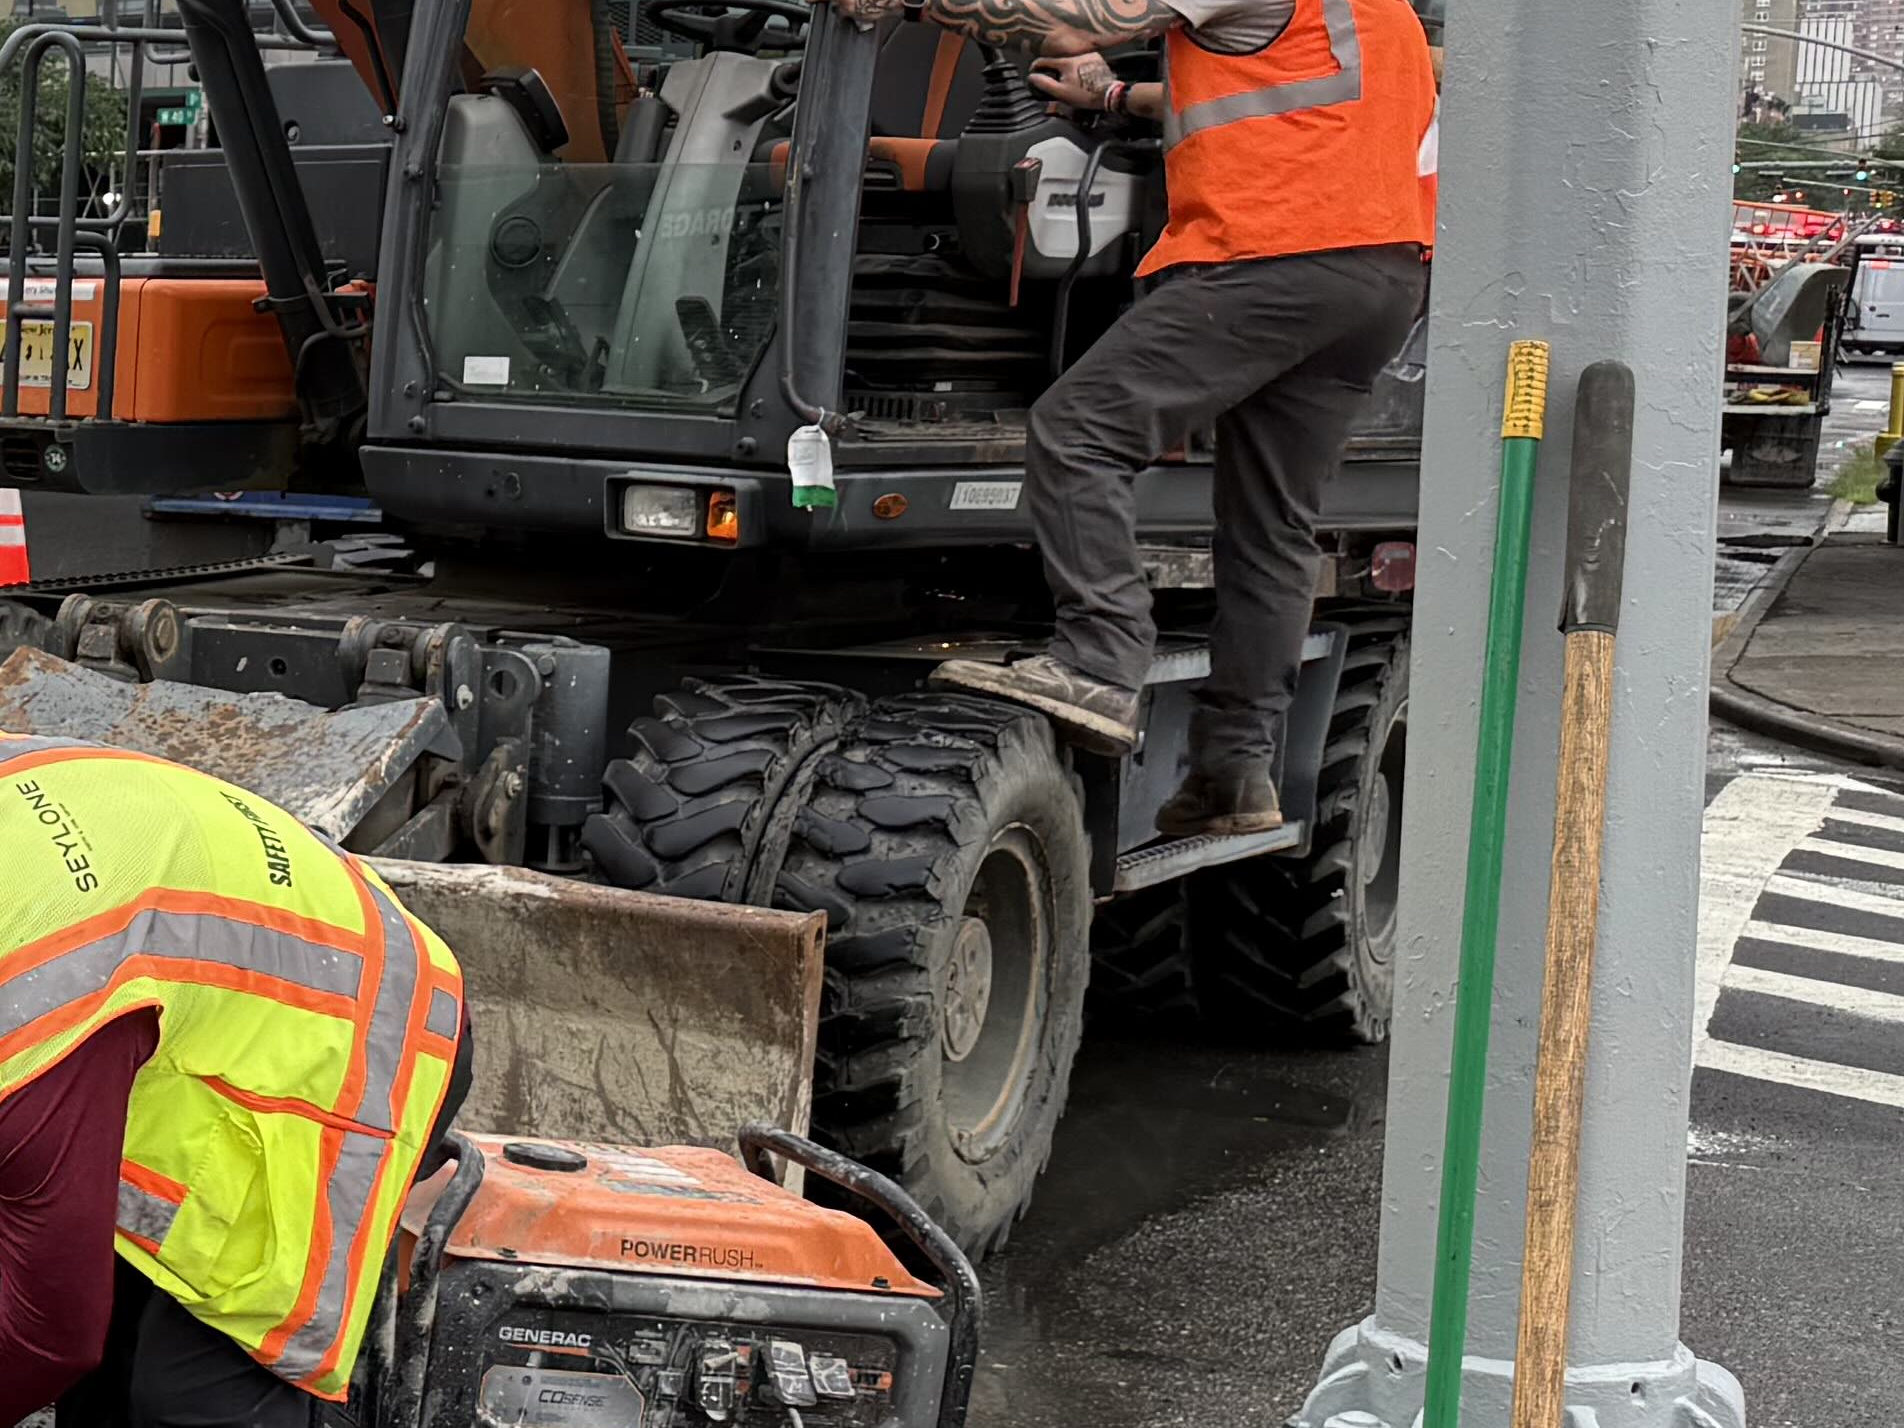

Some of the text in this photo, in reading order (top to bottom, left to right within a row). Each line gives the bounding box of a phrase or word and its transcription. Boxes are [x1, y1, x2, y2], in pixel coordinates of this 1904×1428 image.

[15, 779, 99, 894] SEYLONE
[252, 821, 293, 888] SAFETY
[498, 1325, 592, 1348] GENERAC
